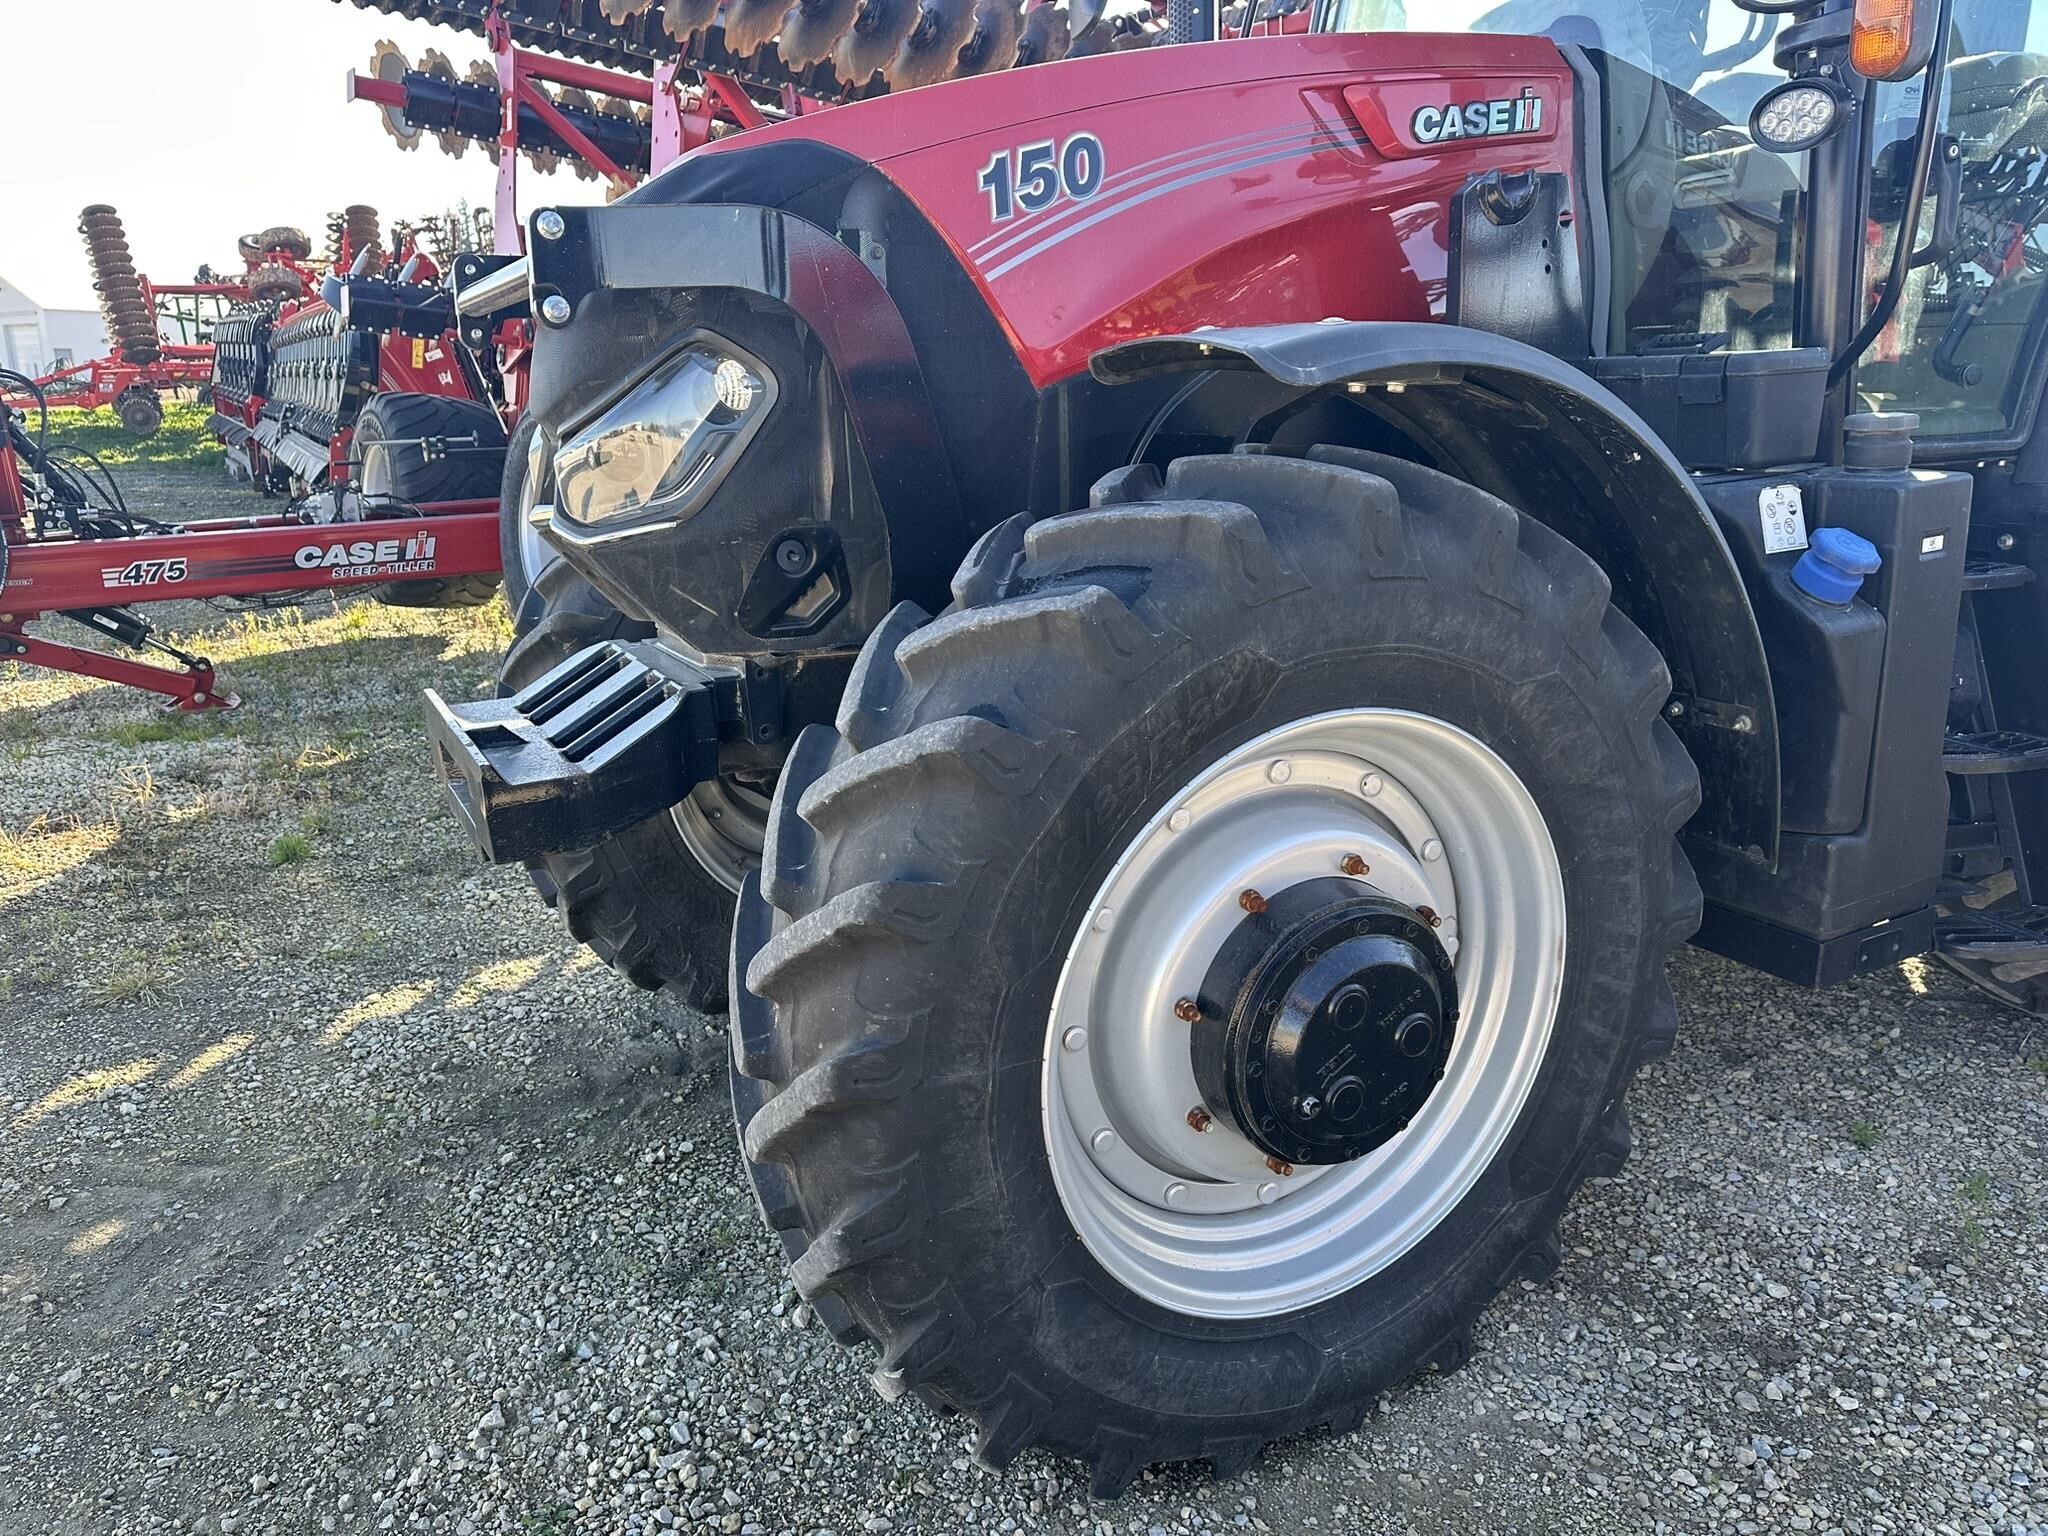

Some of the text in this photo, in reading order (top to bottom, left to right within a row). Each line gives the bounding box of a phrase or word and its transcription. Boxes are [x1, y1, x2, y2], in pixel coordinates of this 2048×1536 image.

[1412, 101, 1511, 143] CASE
[976, 130, 1106, 224] 150
[294, 539, 400, 569] CASE
[118, 557, 188, 586] 475
[331, 560, 436, 579] SPEED-TILLER
